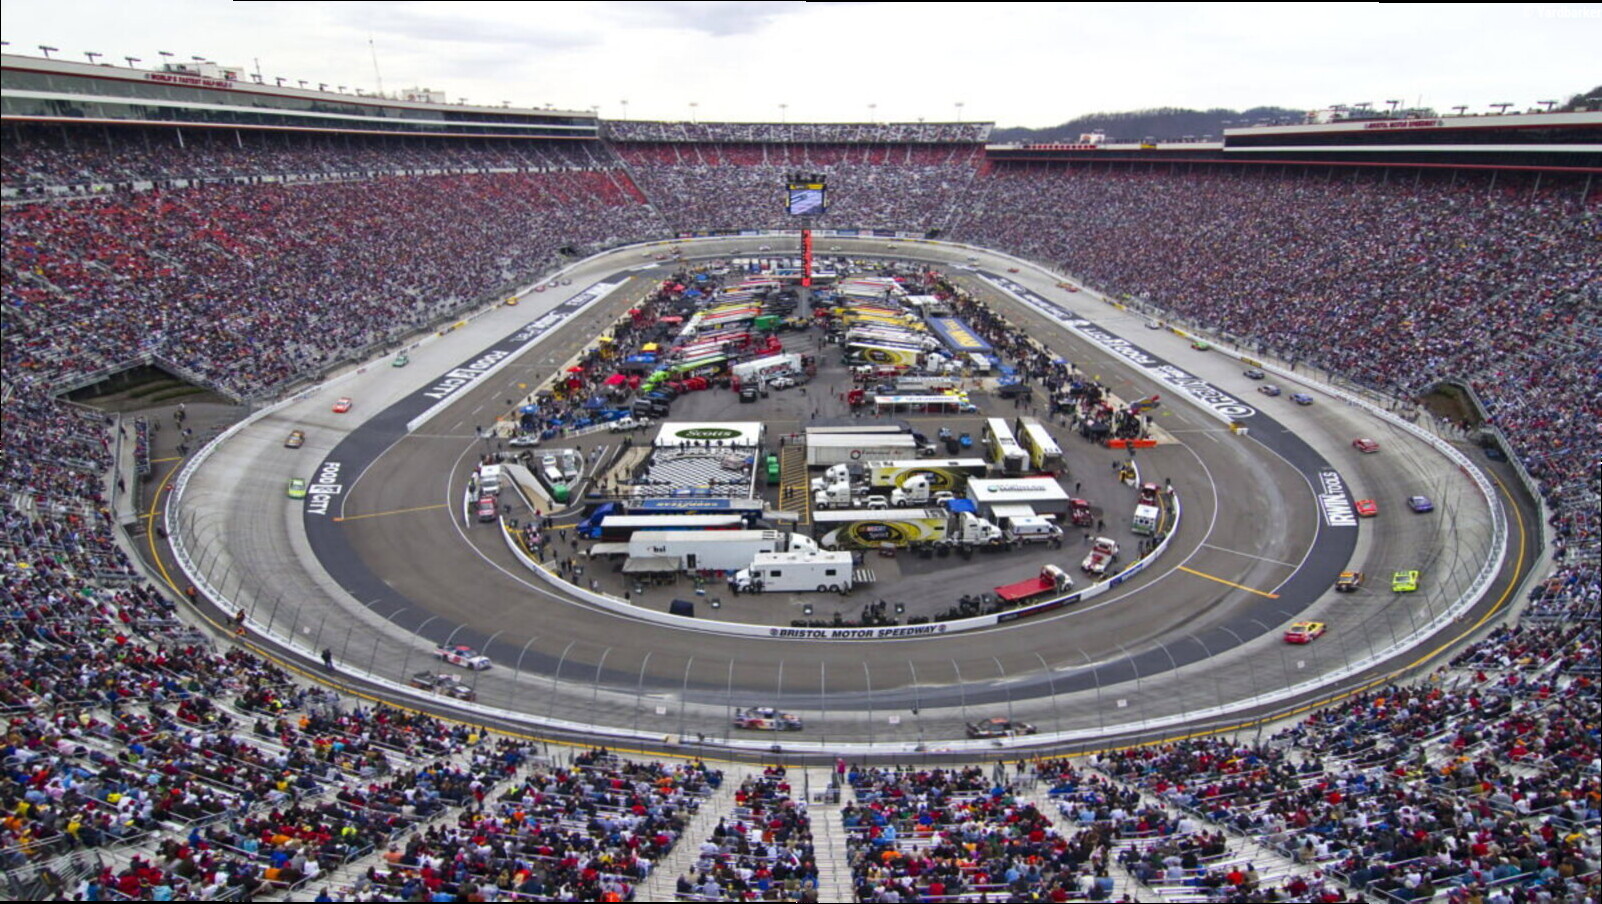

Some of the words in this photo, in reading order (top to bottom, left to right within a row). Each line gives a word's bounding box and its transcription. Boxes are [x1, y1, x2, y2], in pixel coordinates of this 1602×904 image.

[468, 350, 510, 370] FOOD
[423, 378, 466, 400] CITY
[685, 429, 732, 437] Scotts
[319, 462, 341, 484] FOOD
[1322, 471, 1345, 495] TOOLS
[307, 493, 332, 516] CITY
[1321, 493, 1358, 527] IRWIN
[779, 629, 828, 638] BRISTOL
[831, 629, 874, 638] MOTOR
[877, 625, 938, 638] SPEEDWAY
